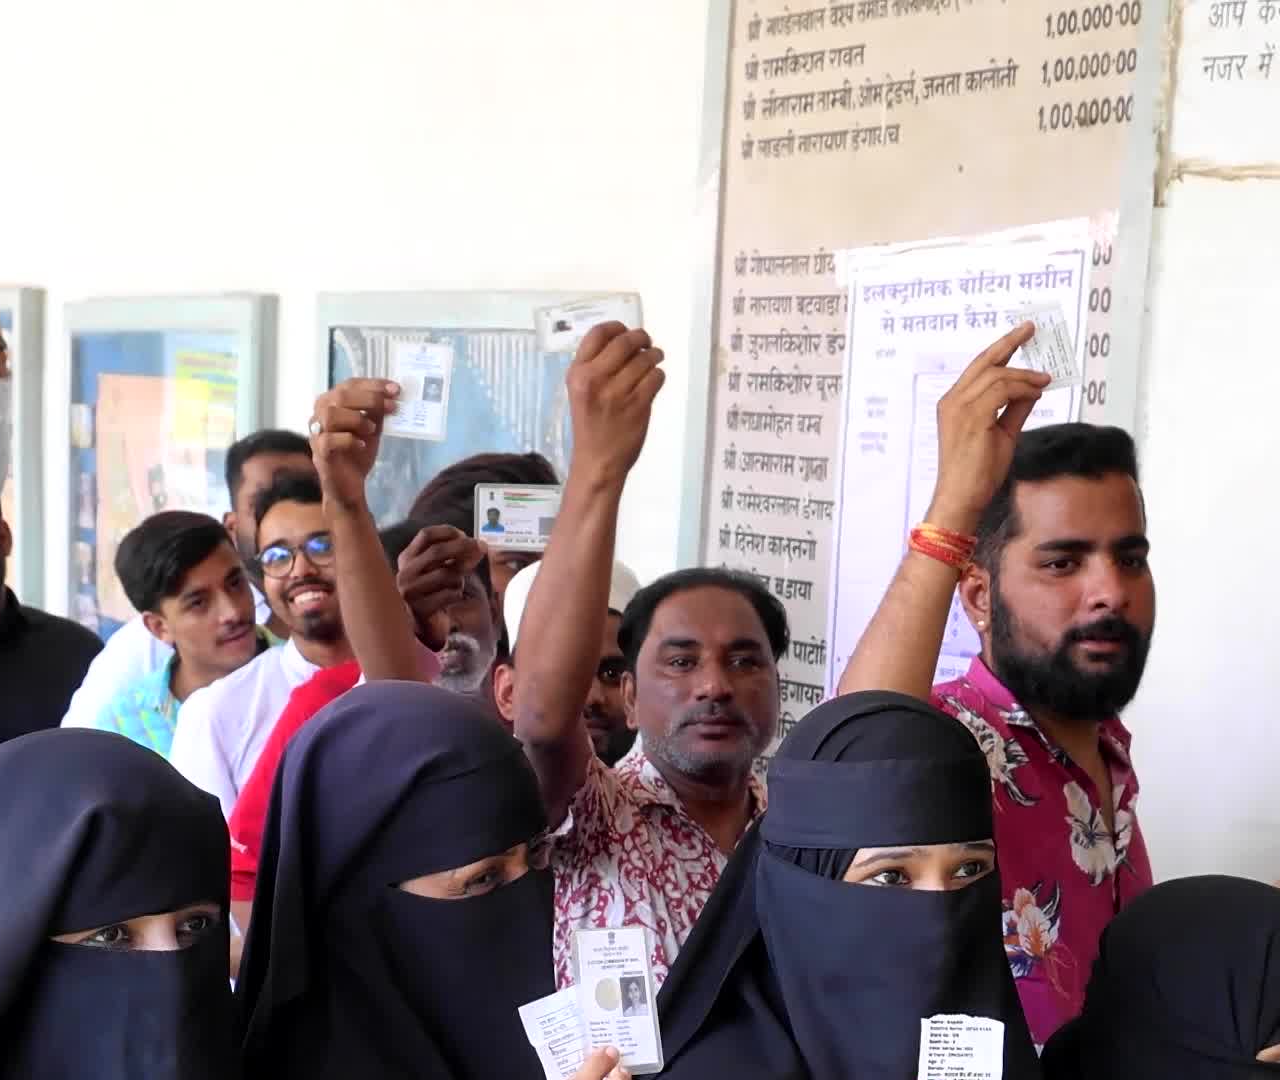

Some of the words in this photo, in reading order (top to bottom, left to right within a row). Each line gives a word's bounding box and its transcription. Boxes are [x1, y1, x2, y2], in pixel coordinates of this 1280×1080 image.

[1259, 41, 1276, 79] में
[1019, 263, 1074, 291] मशीन
[901, 313, 960, 333] मतदान
